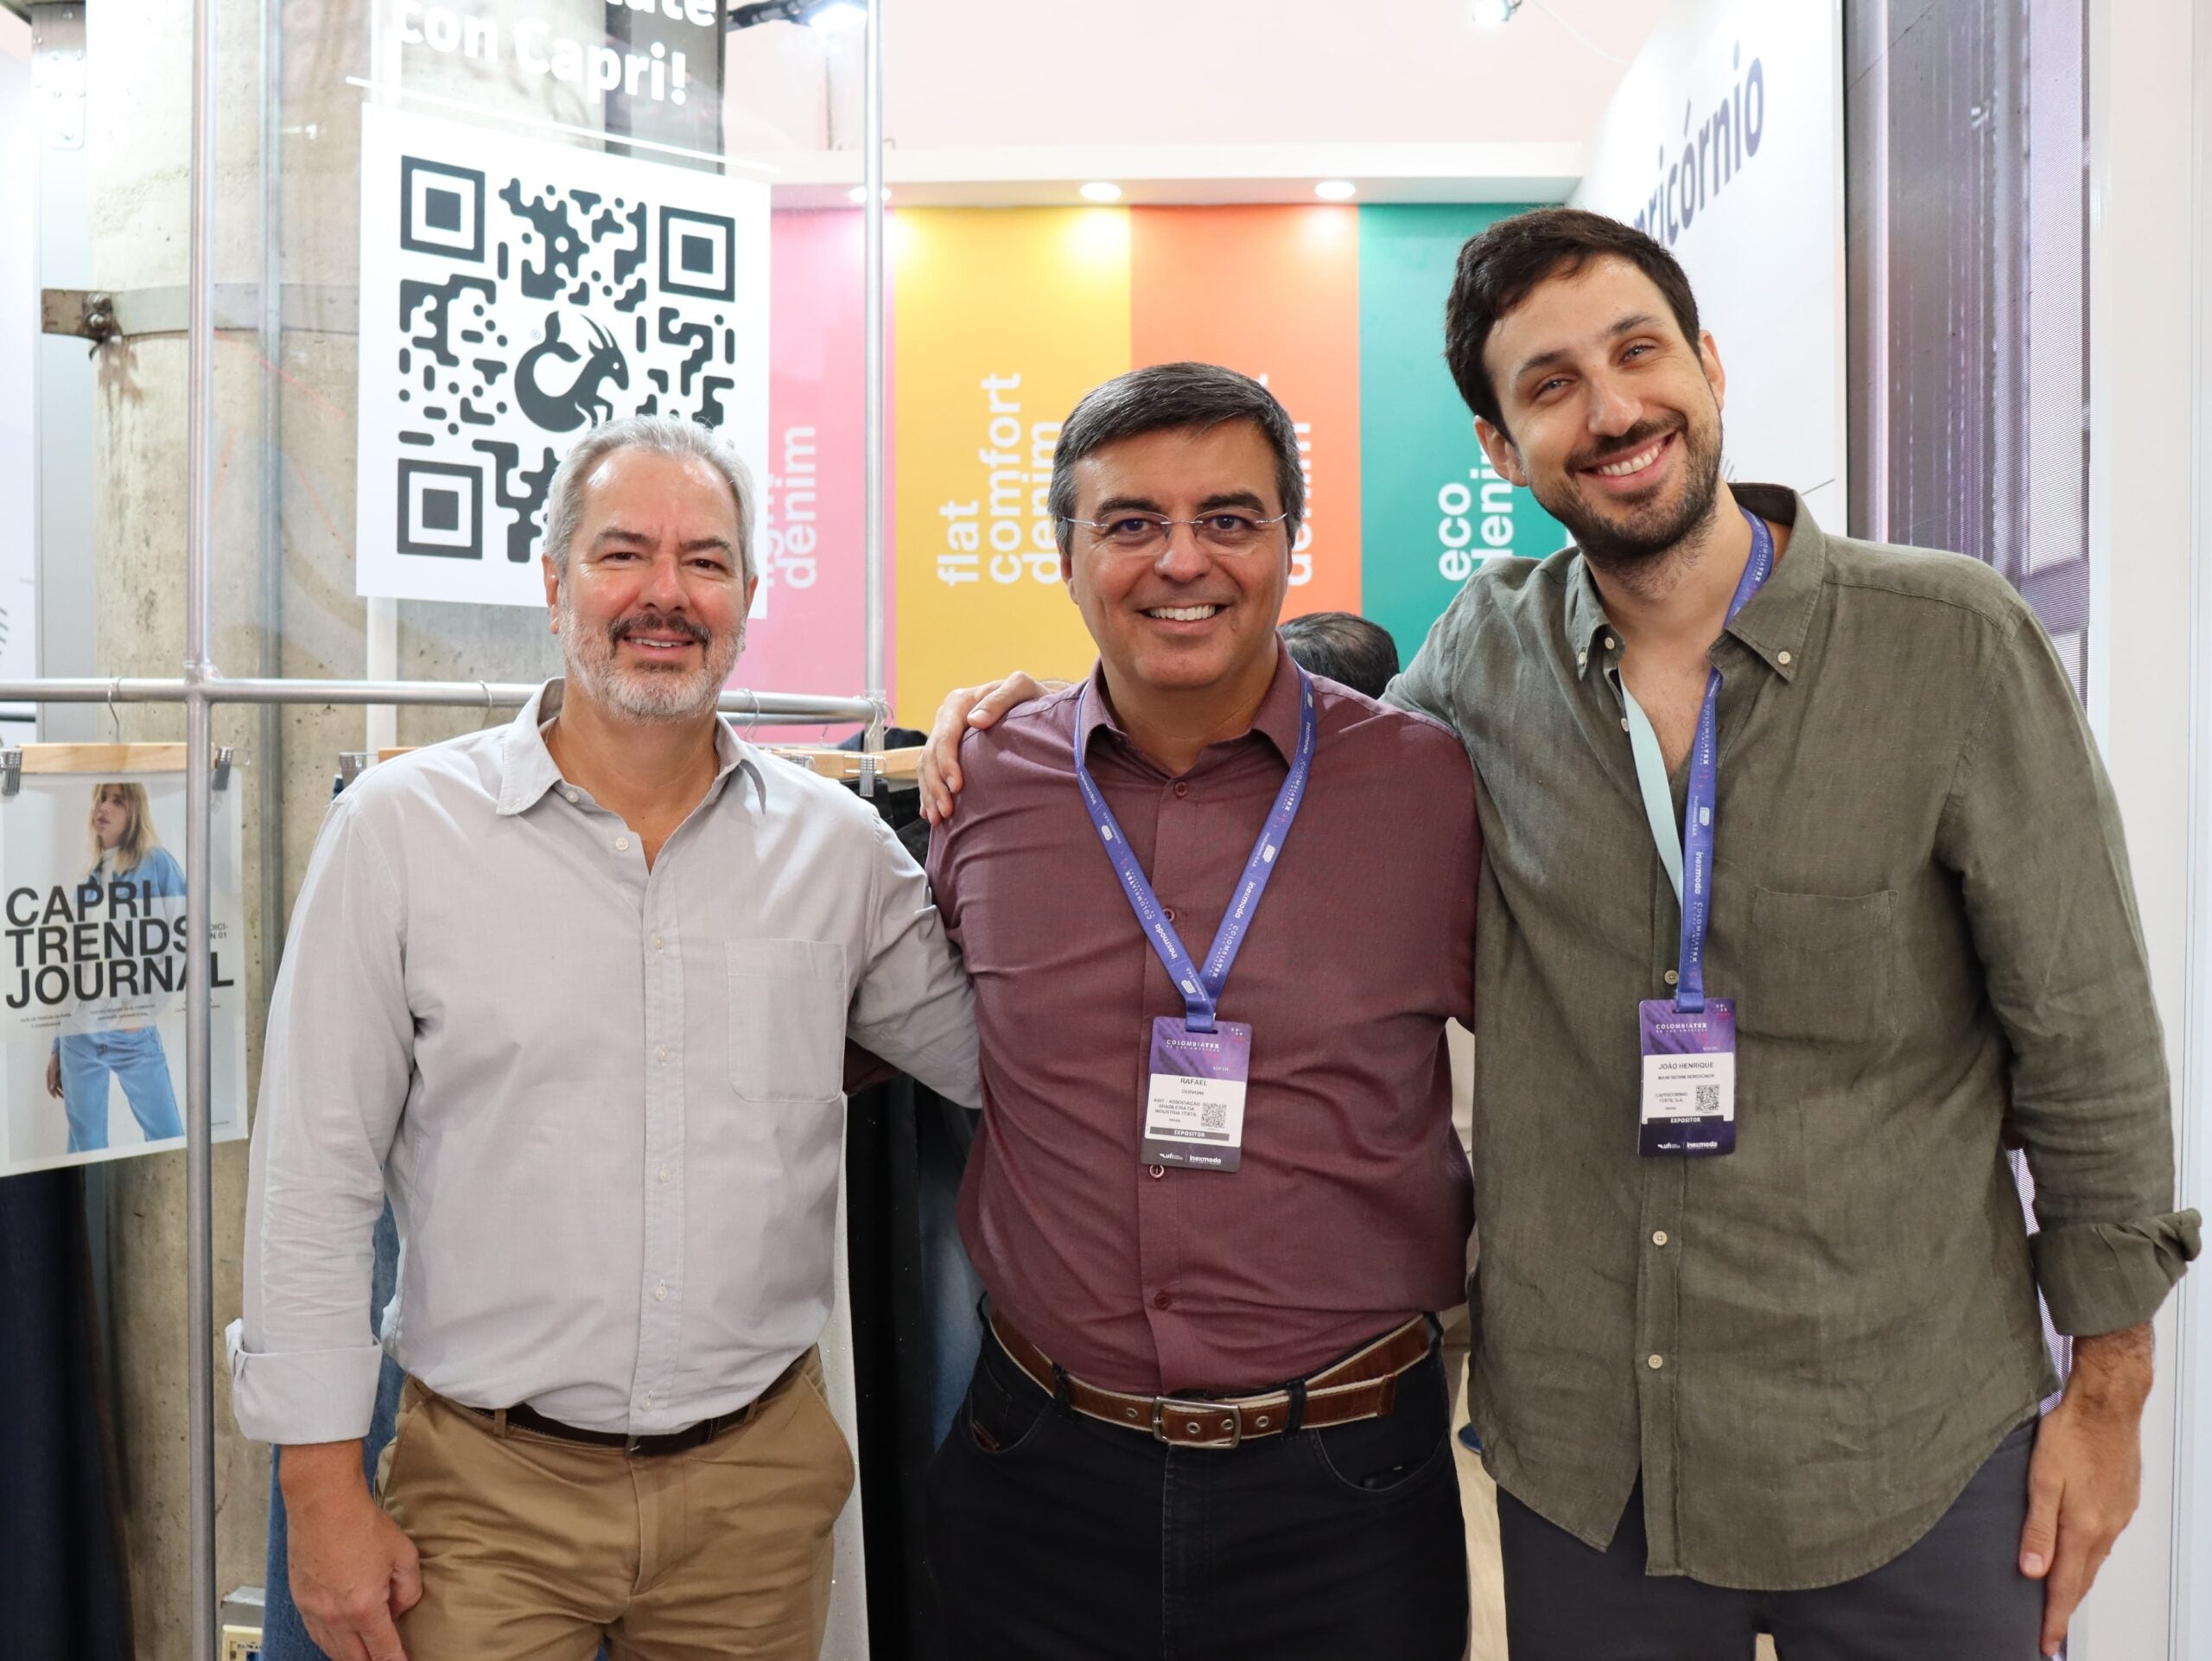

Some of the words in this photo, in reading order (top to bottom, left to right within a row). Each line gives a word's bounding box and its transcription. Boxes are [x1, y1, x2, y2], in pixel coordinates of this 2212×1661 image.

[391, 2, 499, 64] con
[512, 16, 687, 106] Capri!
[1634, 39, 1764, 249] ricórnio
[978, 372, 1023, 585] comfort
[1020, 420, 1065, 585] denim
[1470, 442, 1515, 565] eni
[776, 424, 817, 590] denim
[1438, 481, 1473, 582] eco
[937, 499, 981, 587] flat
[1125, 869, 1153, 920] COLOMBIATEX
[1234, 881, 1256, 920] inexmoda
[1694, 851, 1704, 895] inexmoda
[5, 880, 152, 927] CAPRI
[1154, 922, 1179, 960] inexmoda
[1211, 923, 1239, 979] COLOMBIATEX
[1166, 1039, 1220, 1049] COLOMBIATEX
[1180, 1078, 1208, 1086] RAFAEL
[1189, 1154, 1222, 1163] inexmoda
